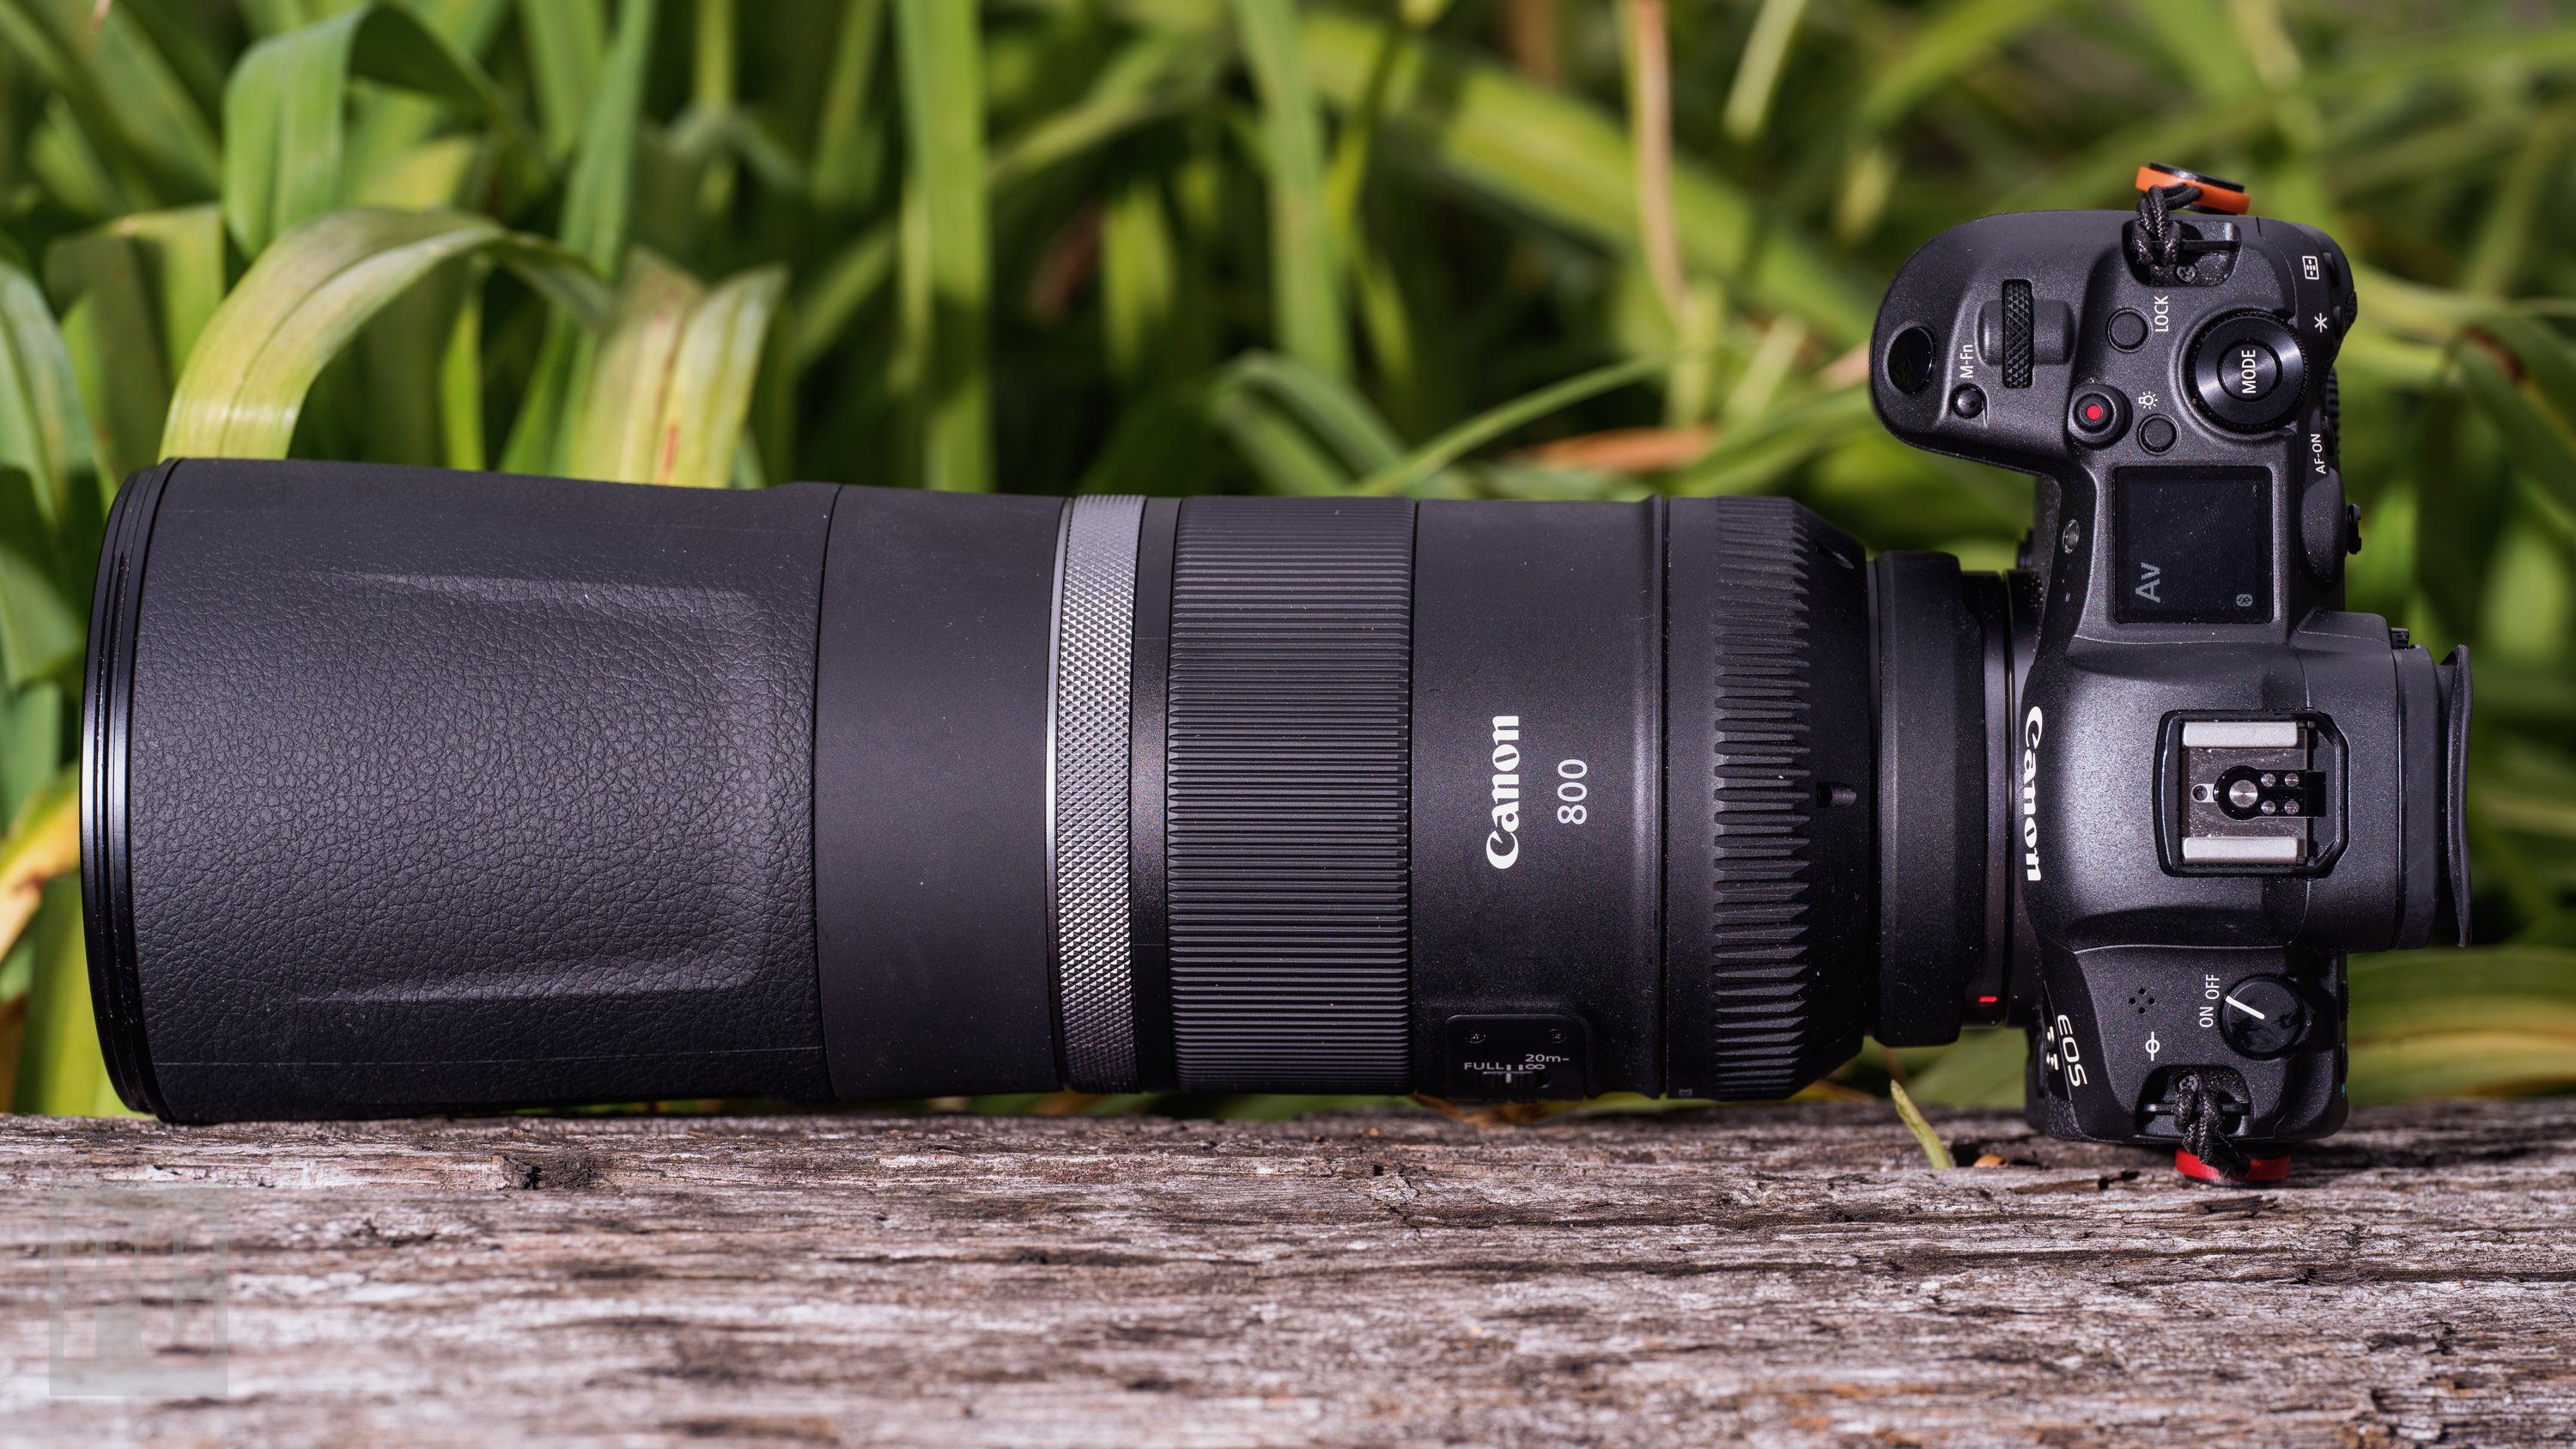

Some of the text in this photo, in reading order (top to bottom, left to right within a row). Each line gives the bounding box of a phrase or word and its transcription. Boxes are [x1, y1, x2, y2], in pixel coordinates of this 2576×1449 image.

[2152, 295, 2169, 333] LOCK
[1959, 344, 1974, 379] M-Fn
[2242, 350, 2258, 394] MODE
[2310, 433, 2327, 474] AF-ON
[2135, 562, 2160, 602] Av
[1485, 715, 1521, 870] Canon
[1556, 758, 1589, 825] 800
[2022, 705, 2044, 881] Canon
[2198, 974, 2221, 1028] ON OFF
[1463, 1062, 1504, 1070] FULL
[2057, 1014, 2088, 1087] EOS
